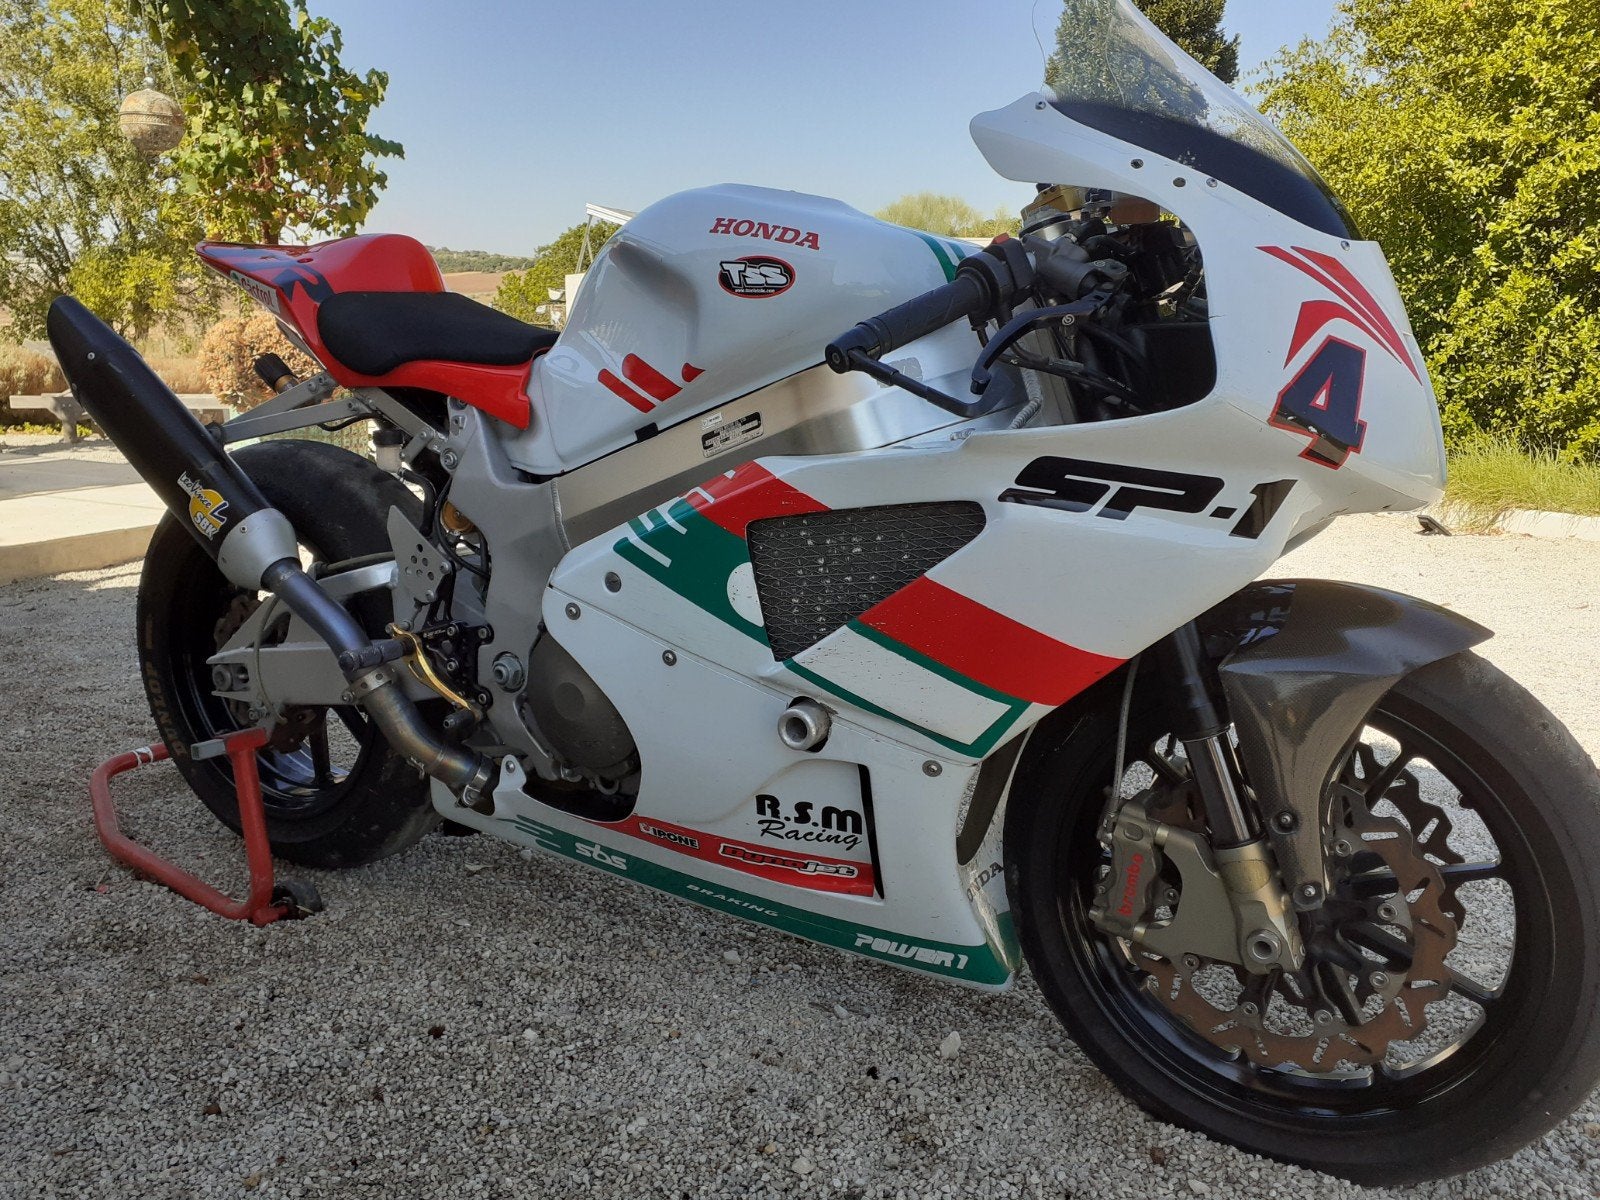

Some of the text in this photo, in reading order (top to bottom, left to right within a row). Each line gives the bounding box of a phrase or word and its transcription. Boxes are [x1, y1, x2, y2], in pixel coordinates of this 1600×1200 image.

[709, 217, 820, 250] HONDA
[720, 261, 790, 288] TSS
[1267, 334, 1368, 470] 4
[179, 473, 211, 508] LeoVince
[194, 511, 218, 540] SBK
[651, 826, 700, 850] IPONE
[757, 819, 862, 852] Racing
[574, 842, 628, 871] sbs
[966, 861, 1004, 903] ONDA
[1117, 852, 1145, 917] brembo
[686, 884, 779, 918] BRAKING
